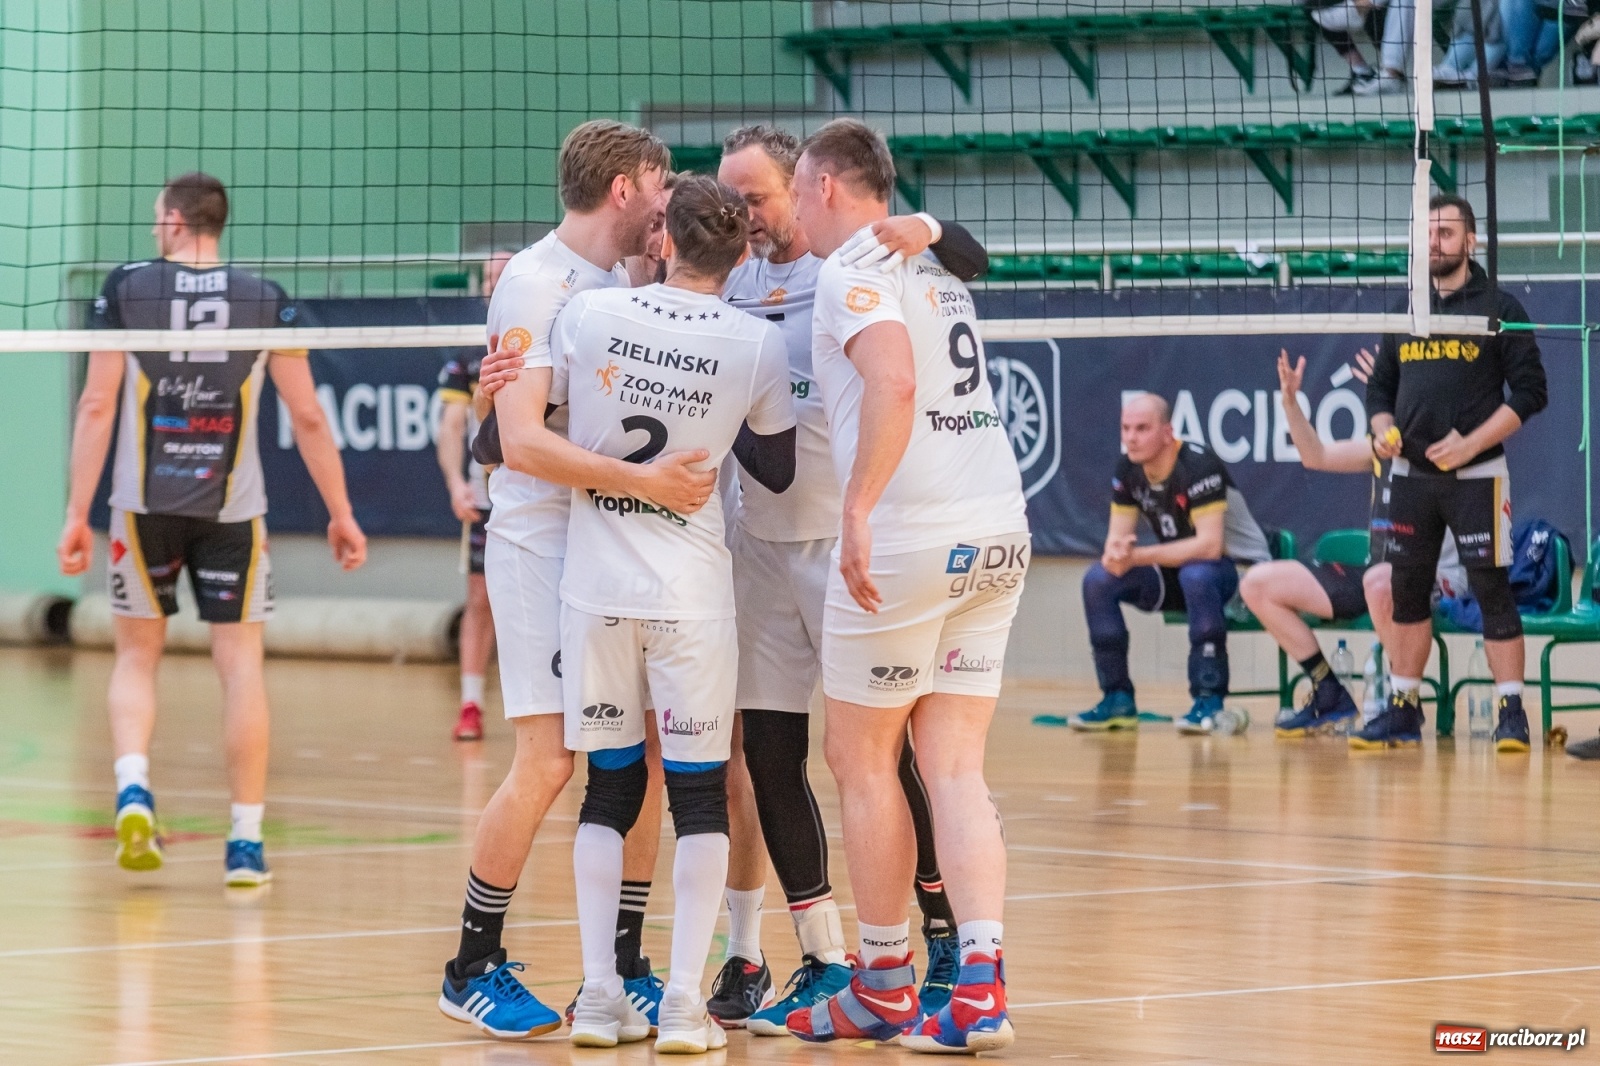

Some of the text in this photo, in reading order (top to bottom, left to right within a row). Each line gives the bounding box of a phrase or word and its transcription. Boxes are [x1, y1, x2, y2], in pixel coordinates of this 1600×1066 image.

[168, 297, 230, 363] 12
[607, 336, 719, 376] ZIELIŃSKI
[949, 321, 981, 397] 9
[622, 373, 713, 405] ZOO-MAR
[619, 390, 709, 419] LUNATYCY
[1121, 364, 1369, 463] ACIBÓ
[620, 414, 669, 464] 2
[984, 544, 1027, 569] DK
[948, 568, 1022, 598] glass
[959, 654, 1003, 673] kolgra
[869, 678, 918, 688] wepol
[581, 719, 624, 727] wepol
[672, 716, 719, 736] kolgraf
[862, 936, 908, 947] GIOCCA
